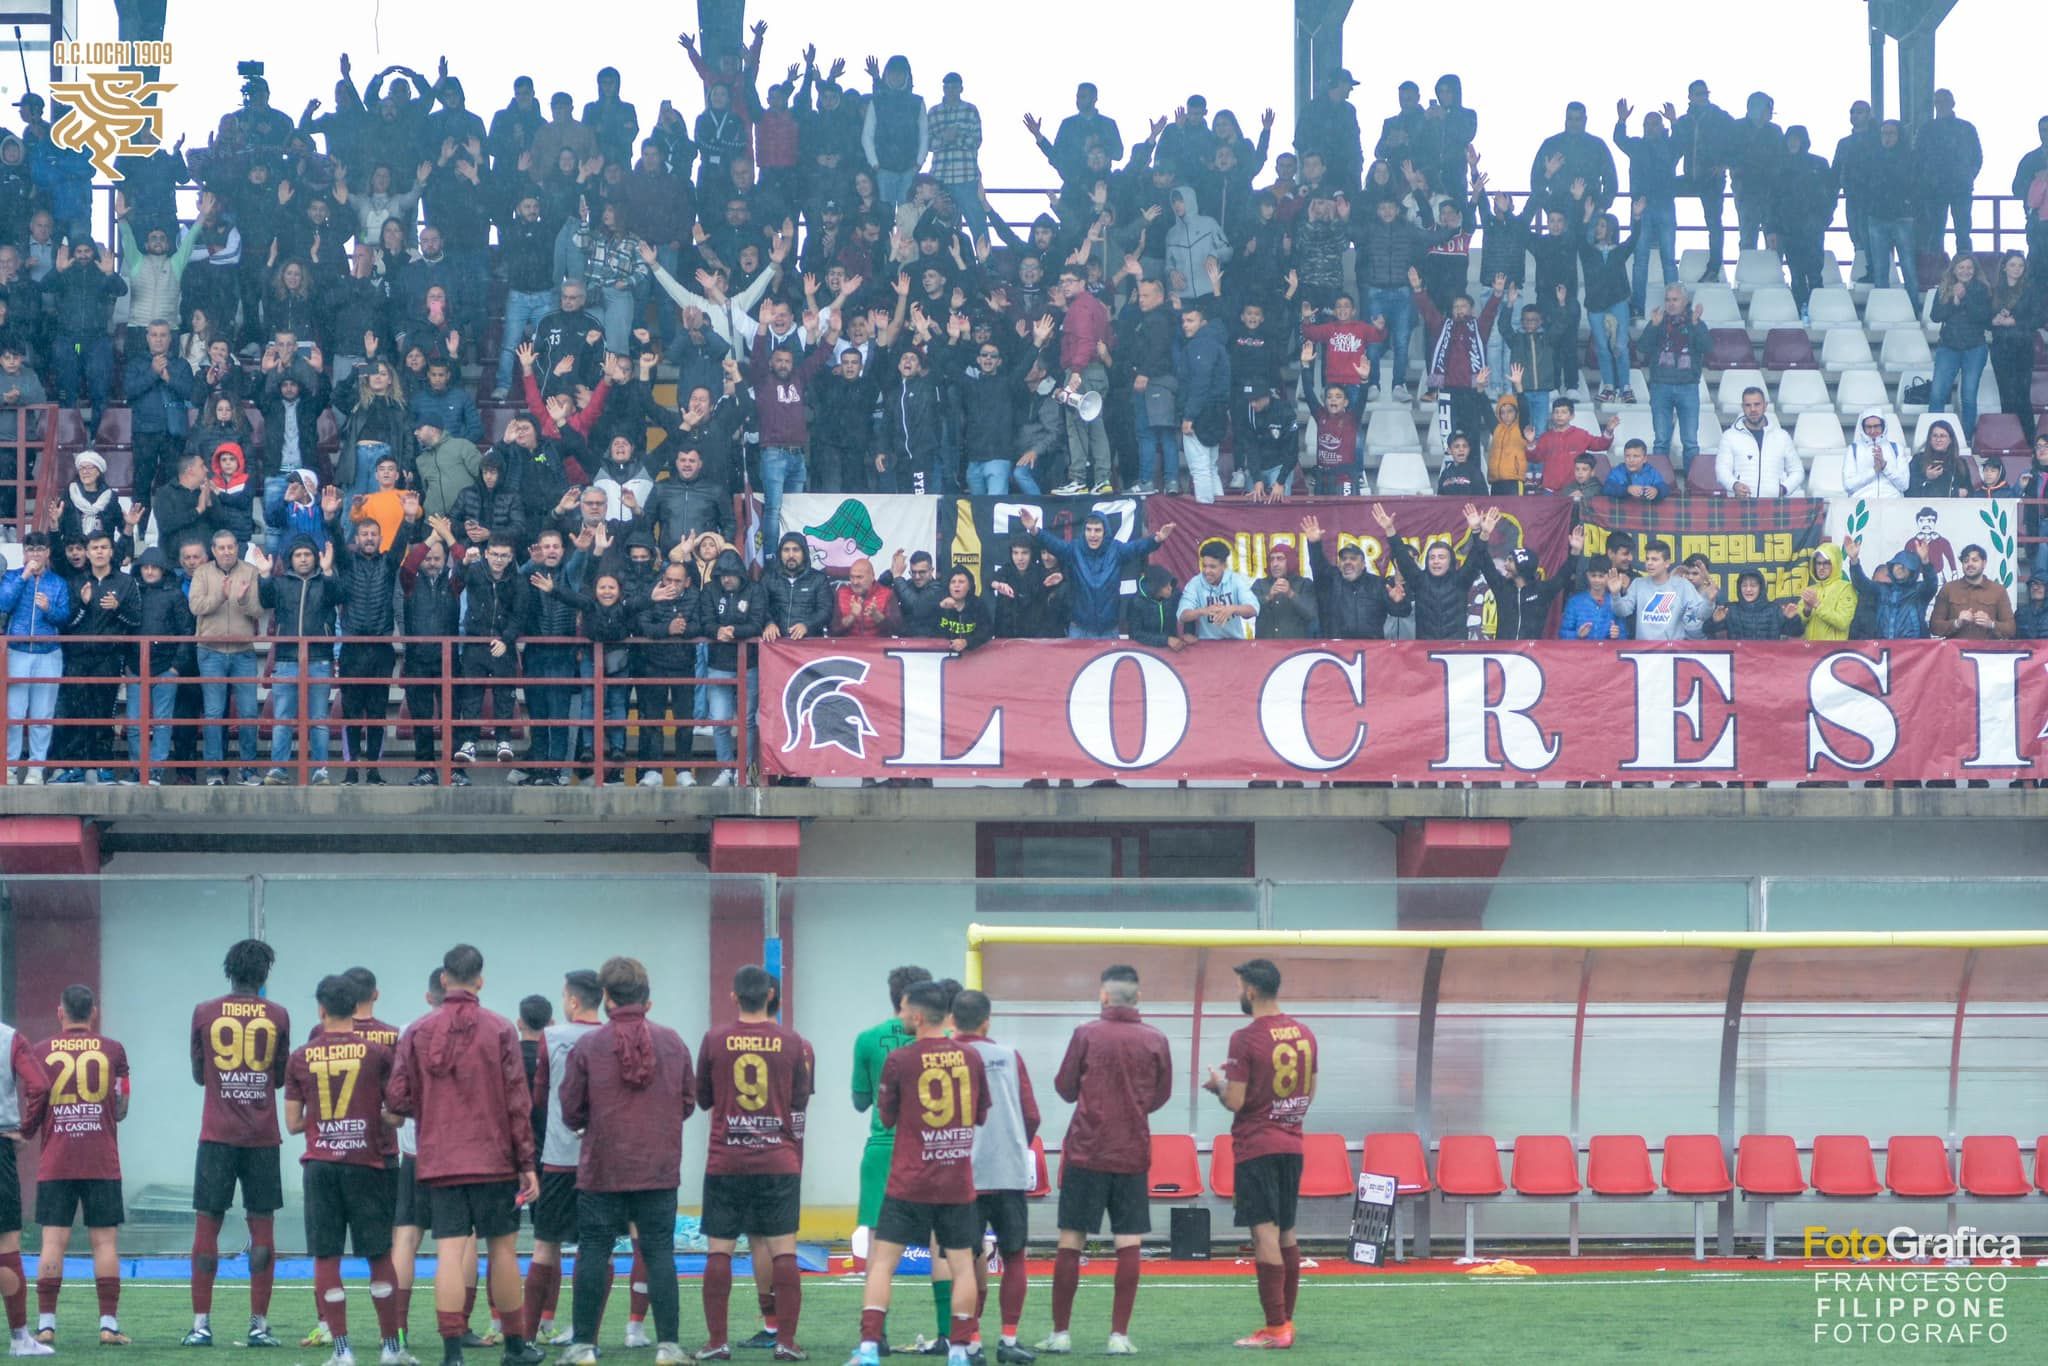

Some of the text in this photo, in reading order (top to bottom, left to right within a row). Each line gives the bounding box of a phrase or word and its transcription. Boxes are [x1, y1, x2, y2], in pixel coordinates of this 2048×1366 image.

[51, 1038, 102, 1052] PAGANO
[210, 1016, 277, 1072] 90
[726, 1036, 783, 1052] CARELLA
[305, 1043, 367, 1063] PALERMO
[1271, 1039, 1312, 1098] 81
[44, 1050, 109, 1106] 20
[219, 1071, 268, 1083] WANTED
[733, 1053, 769, 1112] 9
[309, 1058, 361, 1121] 17
[918, 1065, 973, 1129] 91
[53, 1103, 103, 1115] WANTED
[54, 1121, 102, 1133] LA CASCINA
[317, 1118, 367, 1133] WANTED
[726, 1114, 783, 1128] WANTED
[921, 1128, 974, 1142] WANTED
